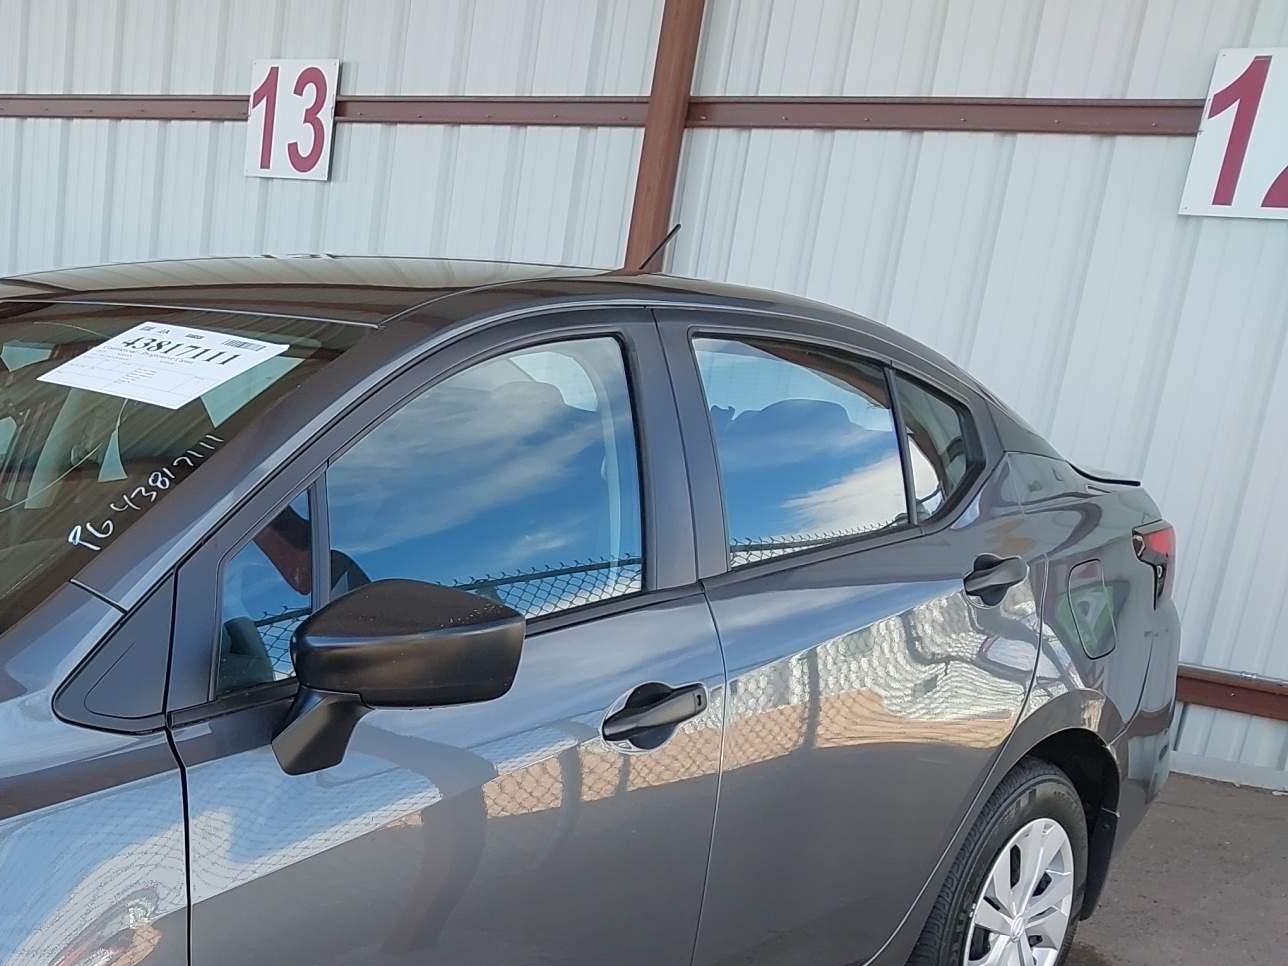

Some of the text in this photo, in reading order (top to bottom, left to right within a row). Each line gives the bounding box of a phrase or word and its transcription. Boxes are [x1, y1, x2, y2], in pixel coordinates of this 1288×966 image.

[252, 66, 328, 173] 13
[1207, 55, 1288, 208] 1
[121, 335, 241, 365] 43817111
[110, 434, 225, 512] 43817111
